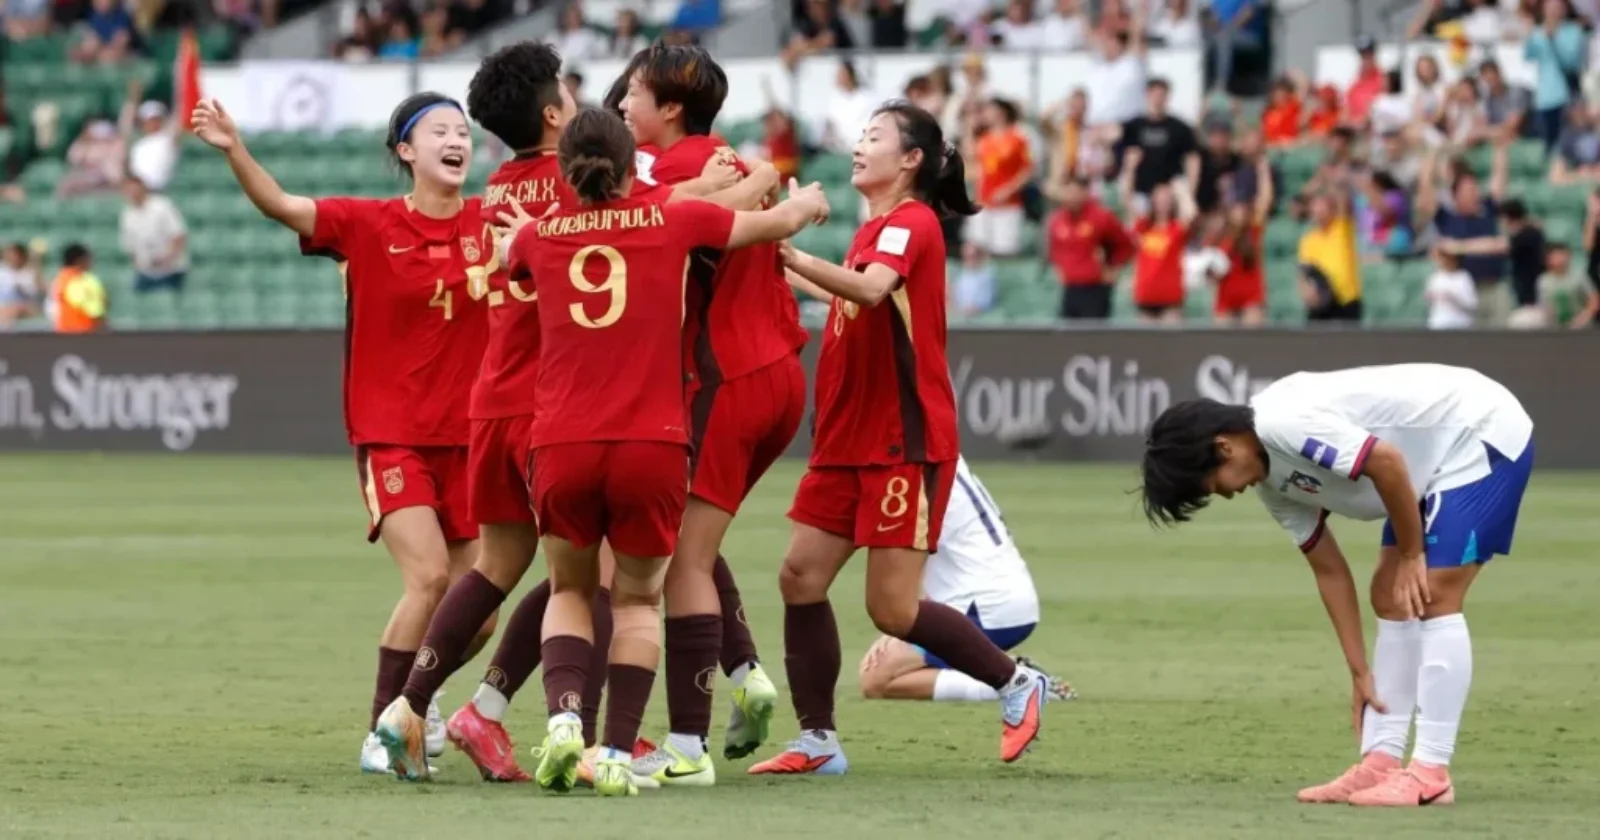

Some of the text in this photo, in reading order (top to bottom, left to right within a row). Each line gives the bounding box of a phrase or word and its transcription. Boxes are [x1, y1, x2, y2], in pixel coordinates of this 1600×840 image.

[536, 204, 665, 238] WURIGUMULA
[429, 278, 453, 320] 4
[568, 244, 628, 329] 9
[51, 353, 239, 450] Stronger
[880, 476, 910, 518] 8
